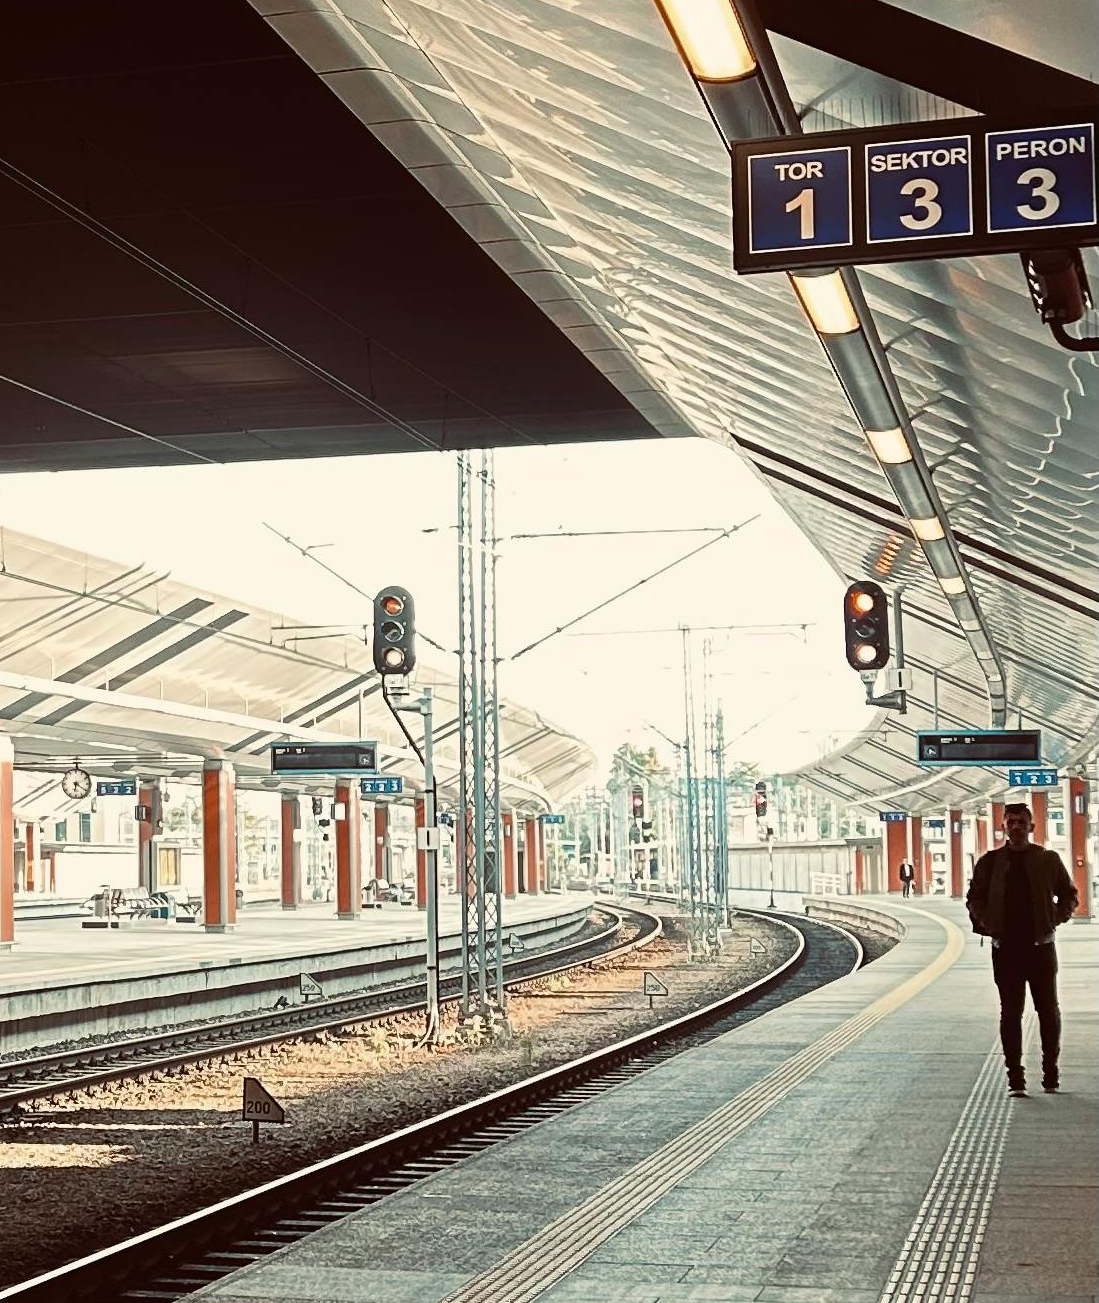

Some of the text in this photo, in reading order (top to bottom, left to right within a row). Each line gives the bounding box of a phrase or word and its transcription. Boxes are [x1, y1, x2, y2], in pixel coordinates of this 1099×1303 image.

[870, 147, 968, 174] SEKTOR
[995, 136, 1087, 161] PERON
[774, 161, 824, 182] TOR
[899, 178, 943, 231] 3
[1015, 167, 1061, 221] 3
[785, 188, 814, 240] 1
[1030, 775, 1038, 784] 2
[1045, 775, 1052, 784] 3
[246, 1100, 271, 1115] 200
